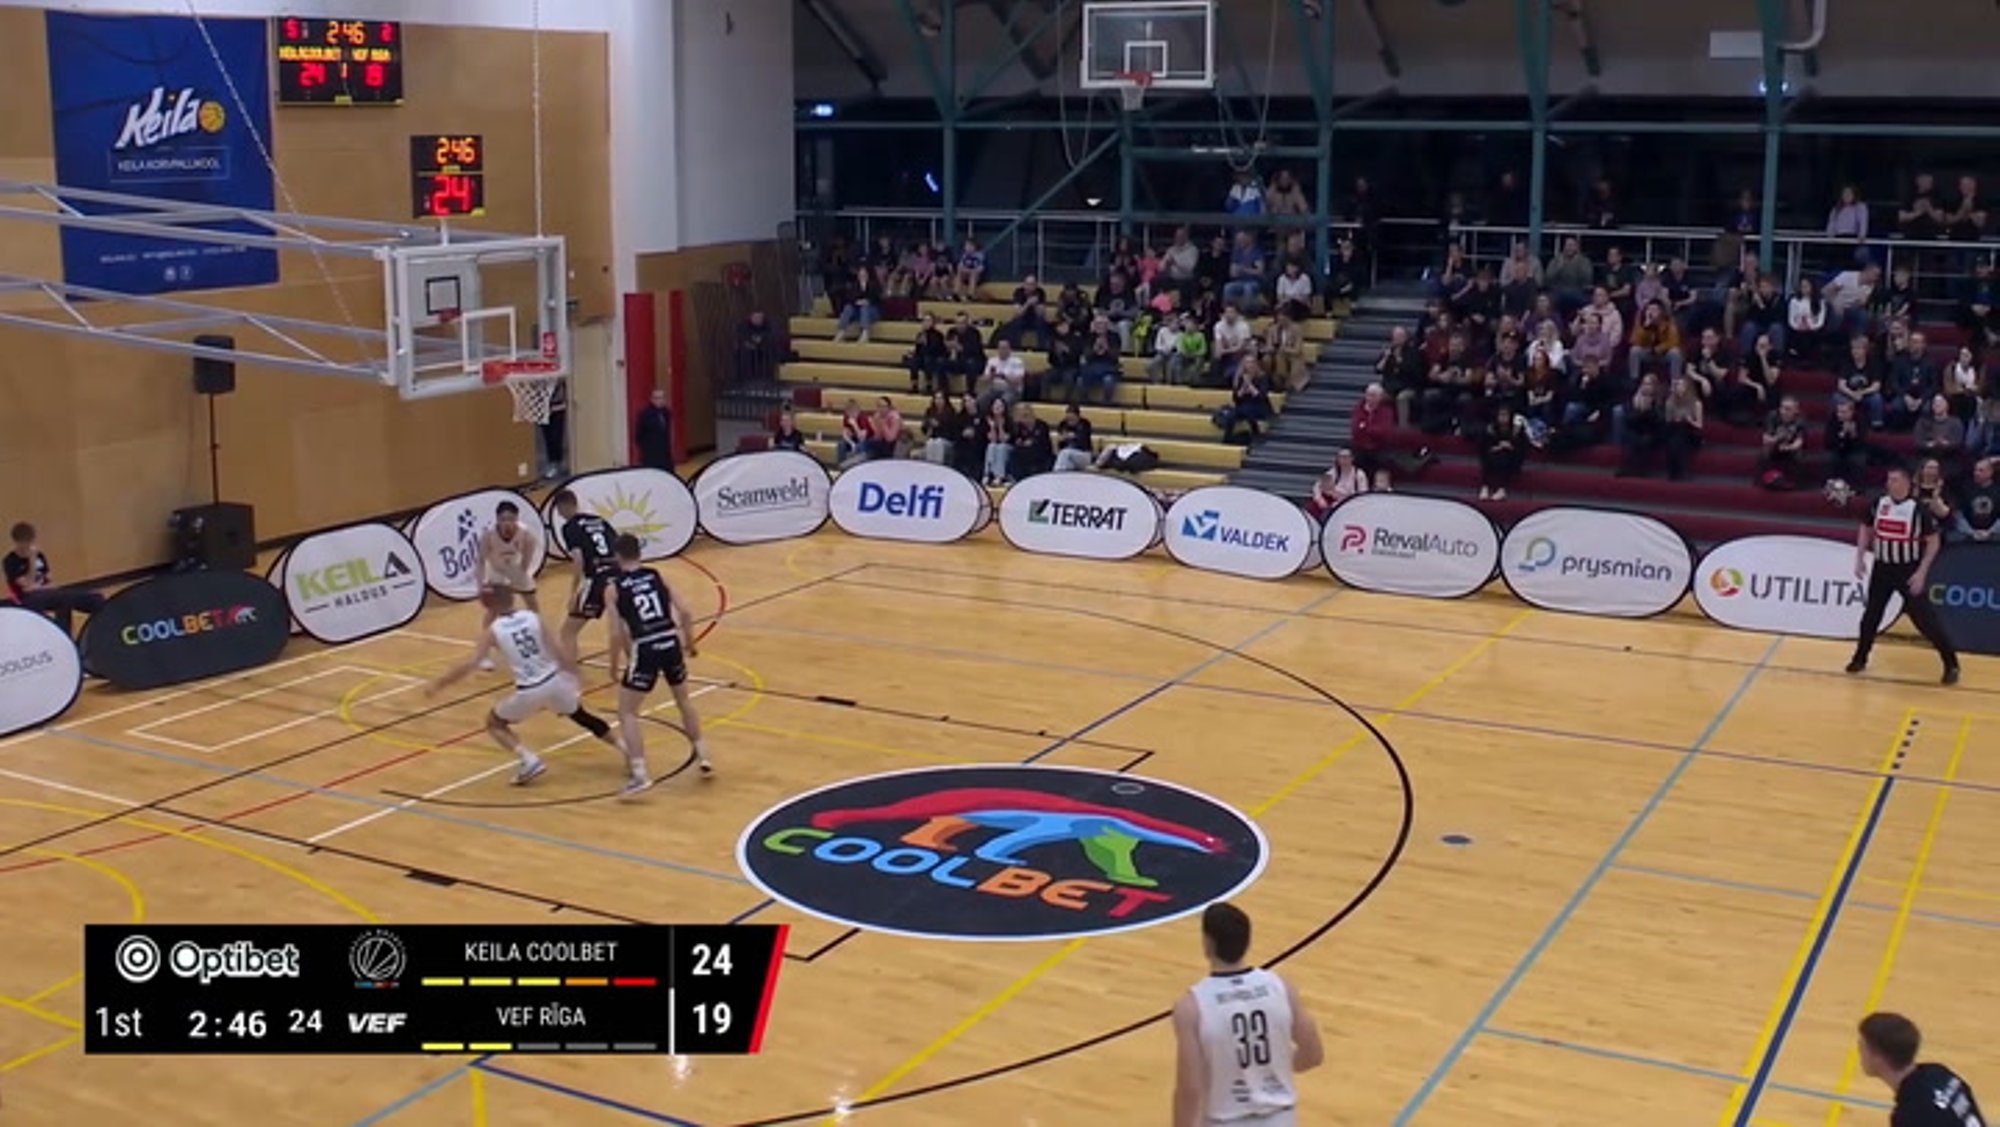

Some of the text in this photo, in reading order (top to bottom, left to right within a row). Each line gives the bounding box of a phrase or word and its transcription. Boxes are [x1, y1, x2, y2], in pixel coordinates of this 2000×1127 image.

[115, 86, 200, 149] Keila
[433, 175, 470, 215] 24
[717, 477, 809, 509] Scanweld
[857, 482, 944, 519] Delfi
[1051, 502, 1128, 531] TERRAT
[592, 532, 609, 555] 3
[1220, 526, 1290, 552] VALDEK
[1373, 527, 1478, 558] RevalAuto
[296, 551, 412, 600] KEILA
[1561, 554, 1672, 581] prysmian
[334, 585, 389, 608] HALDUS
[633, 591, 665, 621] 21
[1929, 584, 2000, 611] COOL
[121, 609, 228, 645] COOLBET
[512, 626, 540, 659] 55
[762, 828, 1172, 918] COOLBET
[1231, 1010, 1271, 1069] 33
